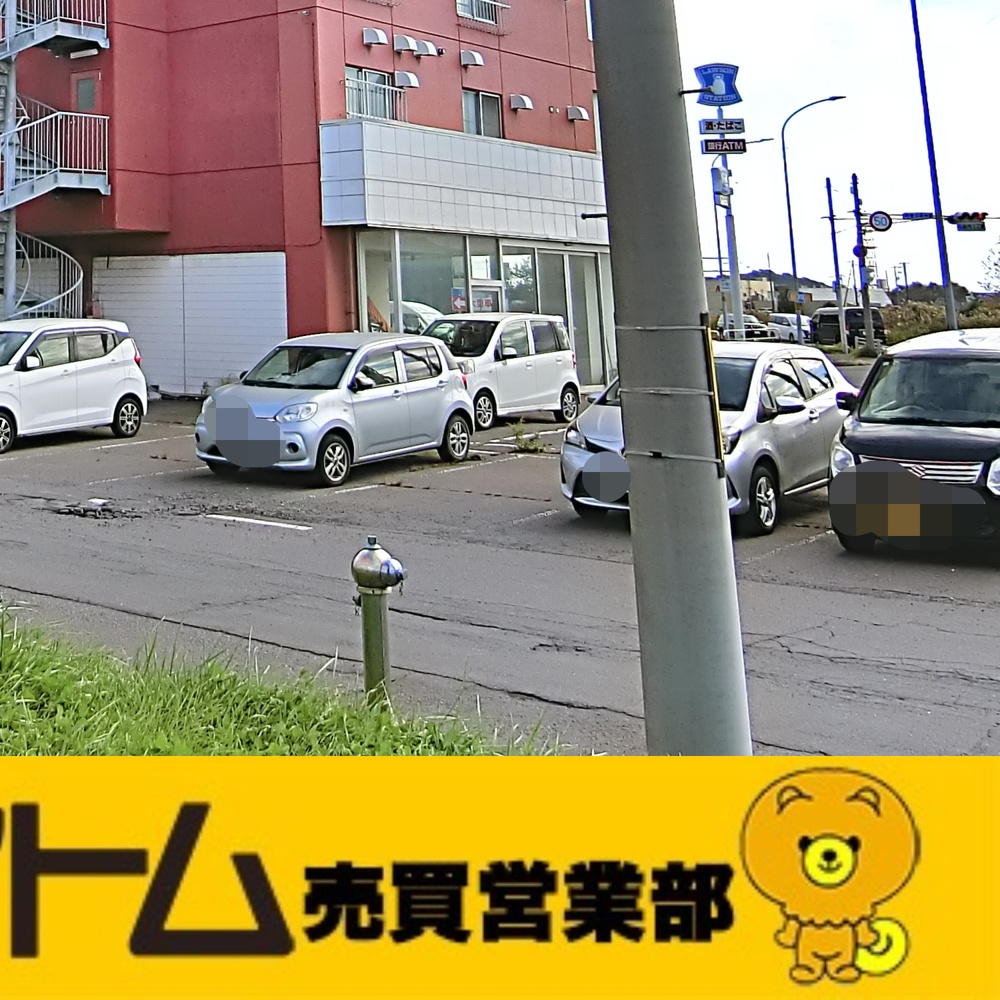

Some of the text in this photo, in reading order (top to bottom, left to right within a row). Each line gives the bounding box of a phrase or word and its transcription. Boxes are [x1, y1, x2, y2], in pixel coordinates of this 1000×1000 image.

[701, 67, 735, 75] LAWSON
[707, 141, 744, 150] 銀行ATM
[873, 216, 887, 227] 50
